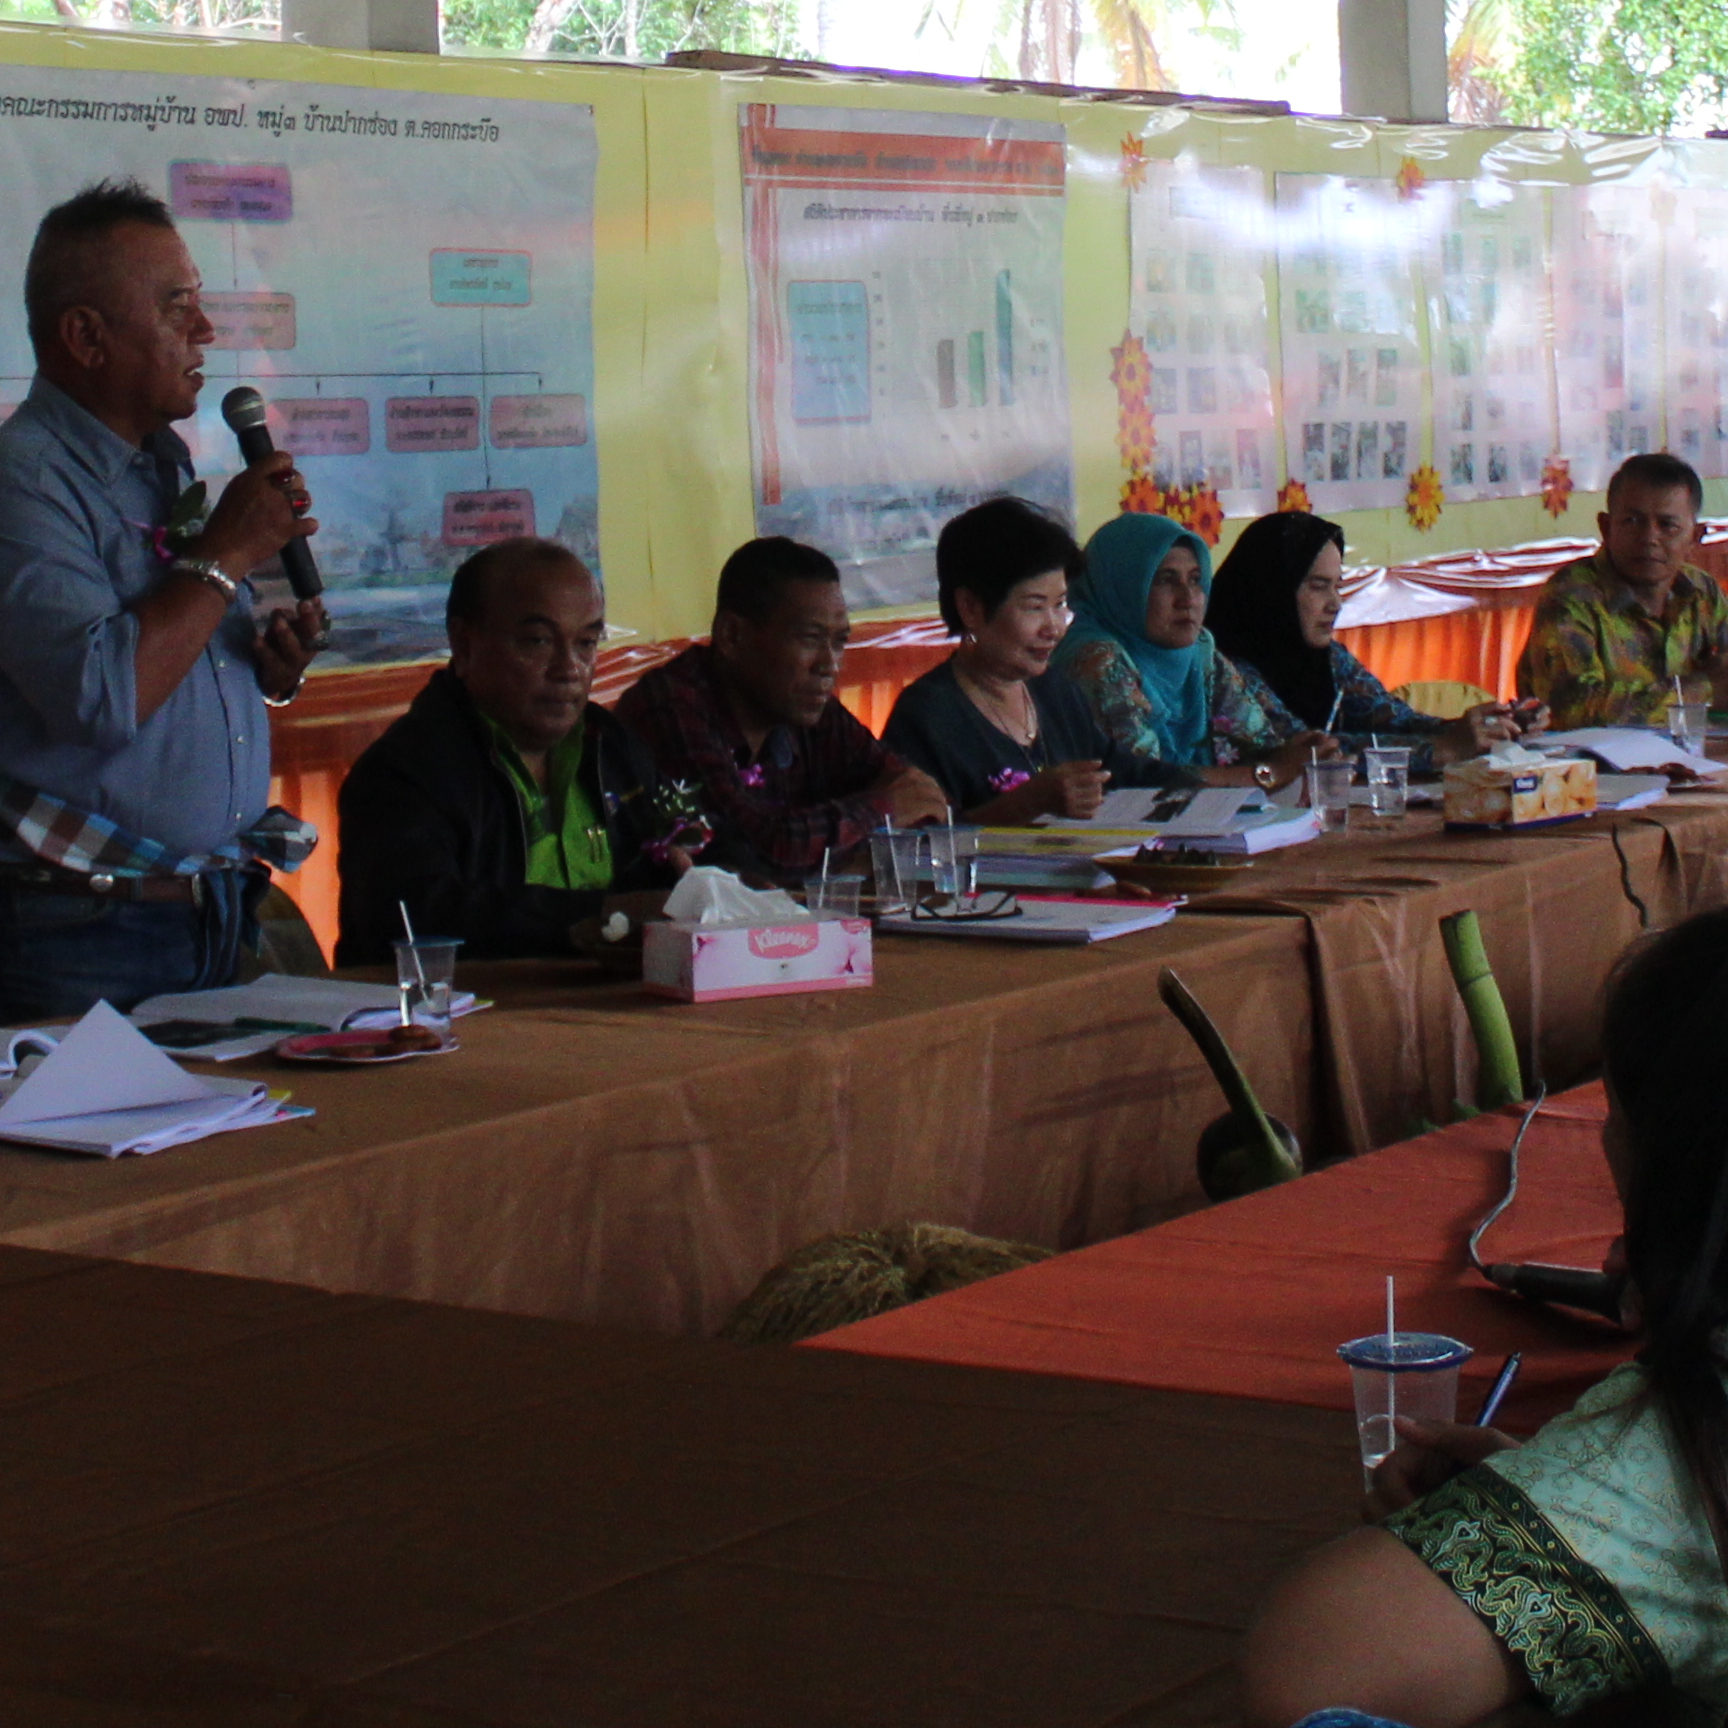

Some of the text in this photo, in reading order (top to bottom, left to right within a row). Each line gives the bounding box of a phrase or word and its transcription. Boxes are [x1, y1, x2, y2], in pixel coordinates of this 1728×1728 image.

[203, 103, 248, 129] อพป.
[304, 104, 398, 136] บ้านปากช่อง
